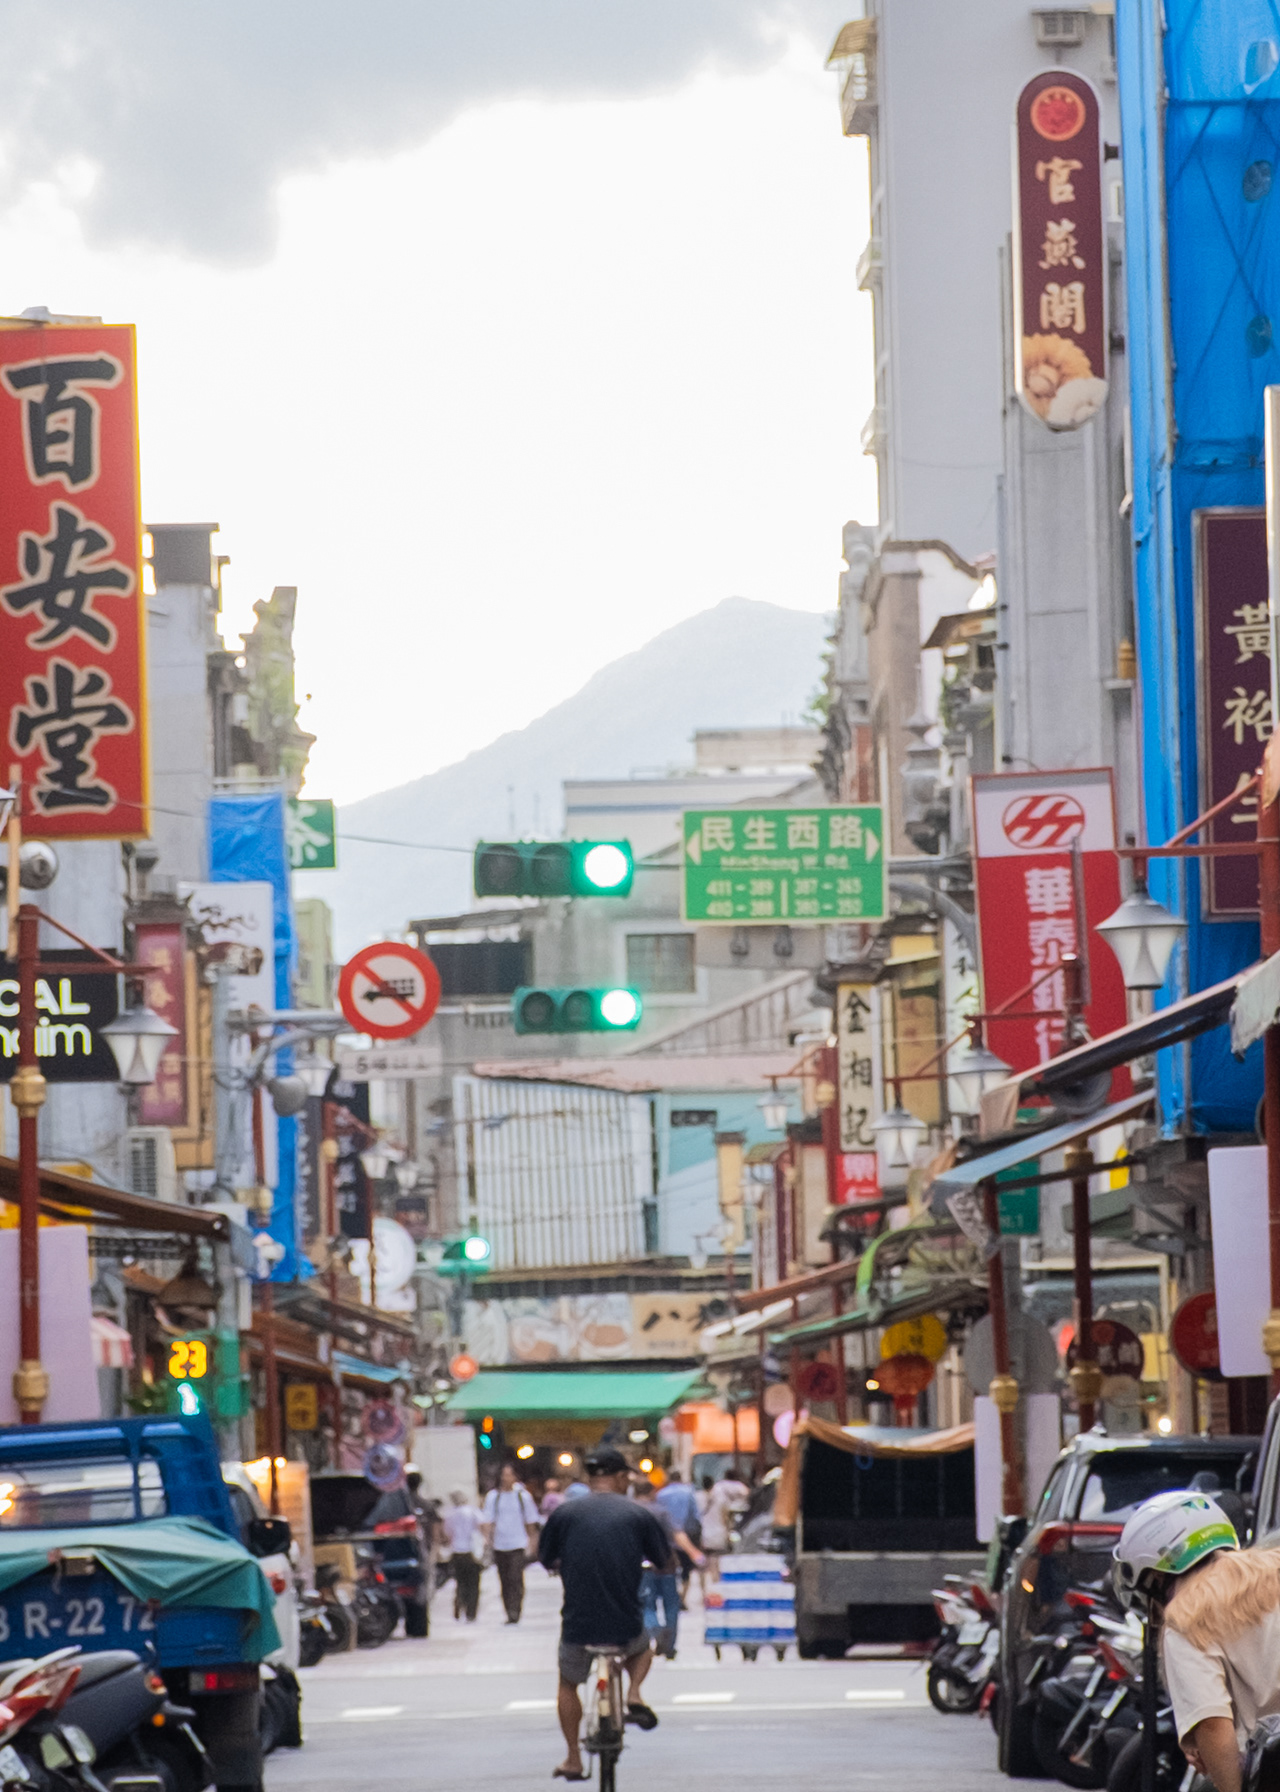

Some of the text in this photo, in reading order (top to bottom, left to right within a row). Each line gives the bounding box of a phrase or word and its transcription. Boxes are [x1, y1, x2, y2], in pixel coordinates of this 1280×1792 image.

[1, 354, 133, 810] 百安堂
[701, 814, 864, 851] 民生西路
